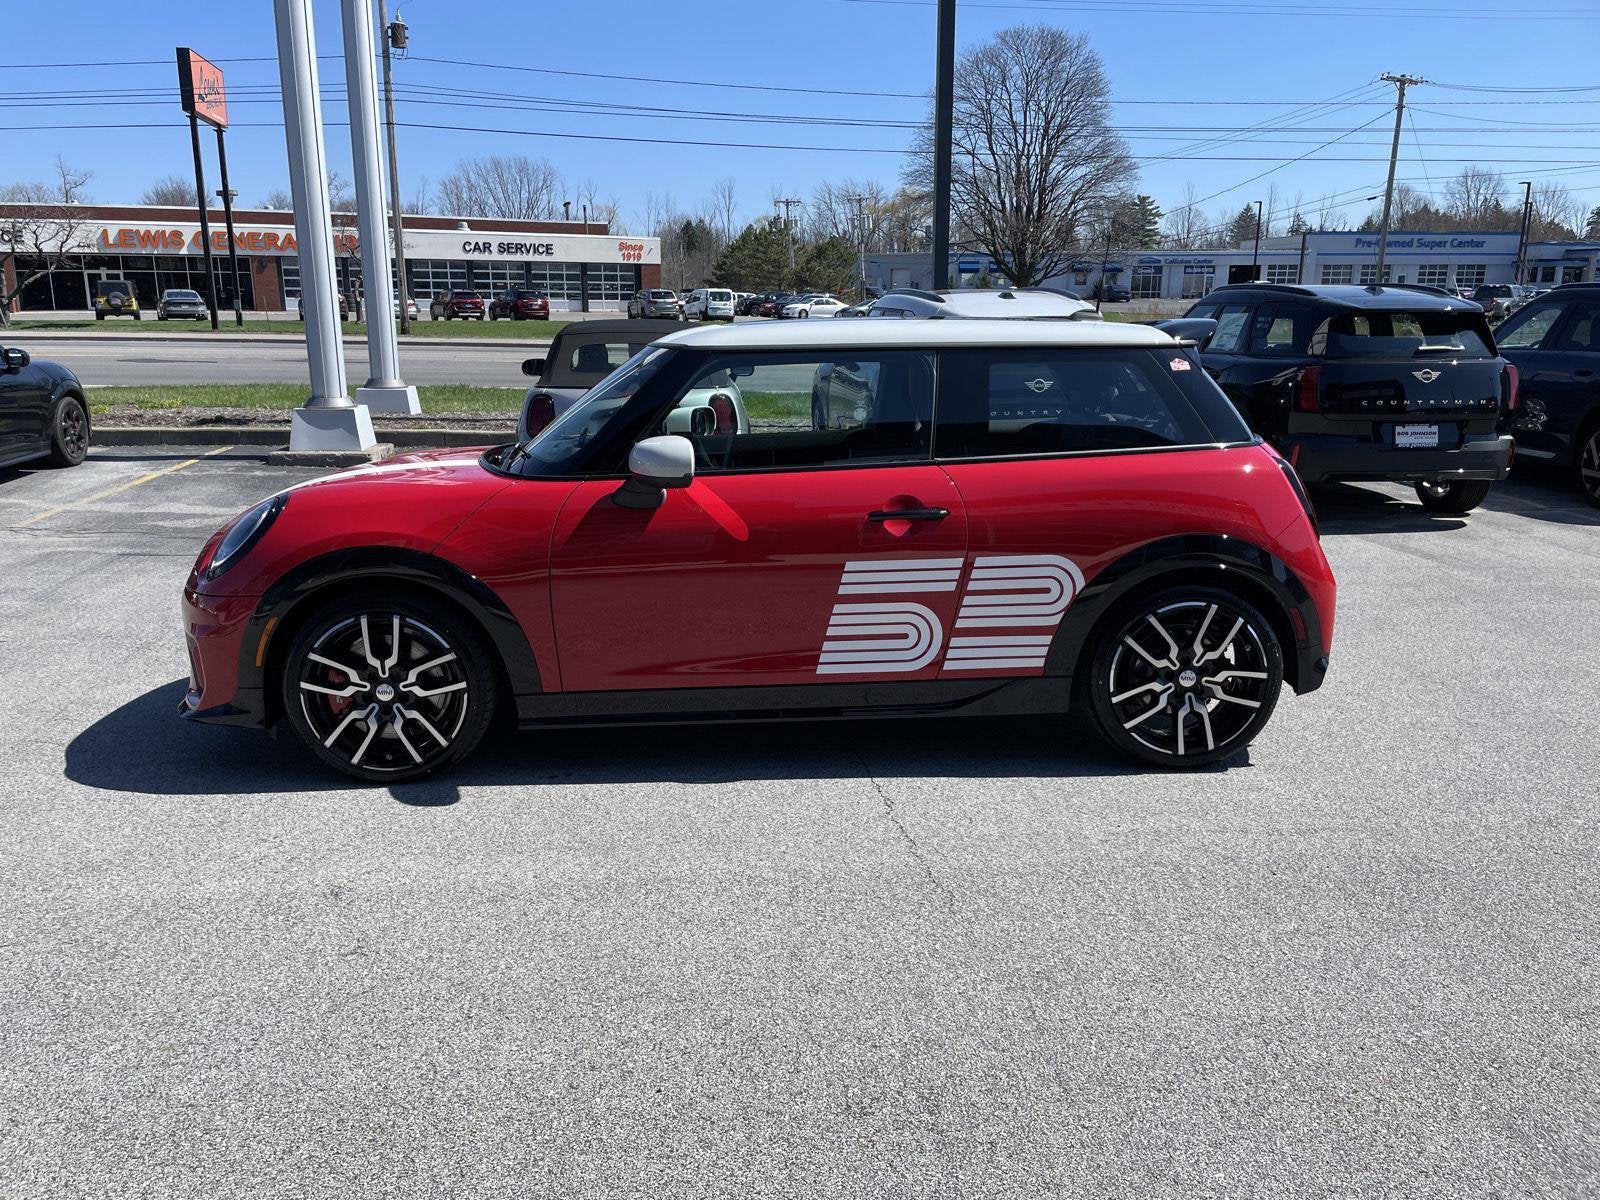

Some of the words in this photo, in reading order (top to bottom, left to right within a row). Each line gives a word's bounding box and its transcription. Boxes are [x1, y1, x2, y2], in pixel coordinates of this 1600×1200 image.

[102, 227, 185, 250] LEWIS
[192, 230, 298, 252] GENERA
[1416, 236, 1448, 250] Super
[1450, 237, 1486, 248] Center
[462, 241, 493, 254] CAR
[497, 243, 554, 256] SERVICE
[618, 241, 644, 253] Since
[1361, 398, 1486, 407] COUNTRYMAN
[990, 408, 1063, 417] OUNTRY
